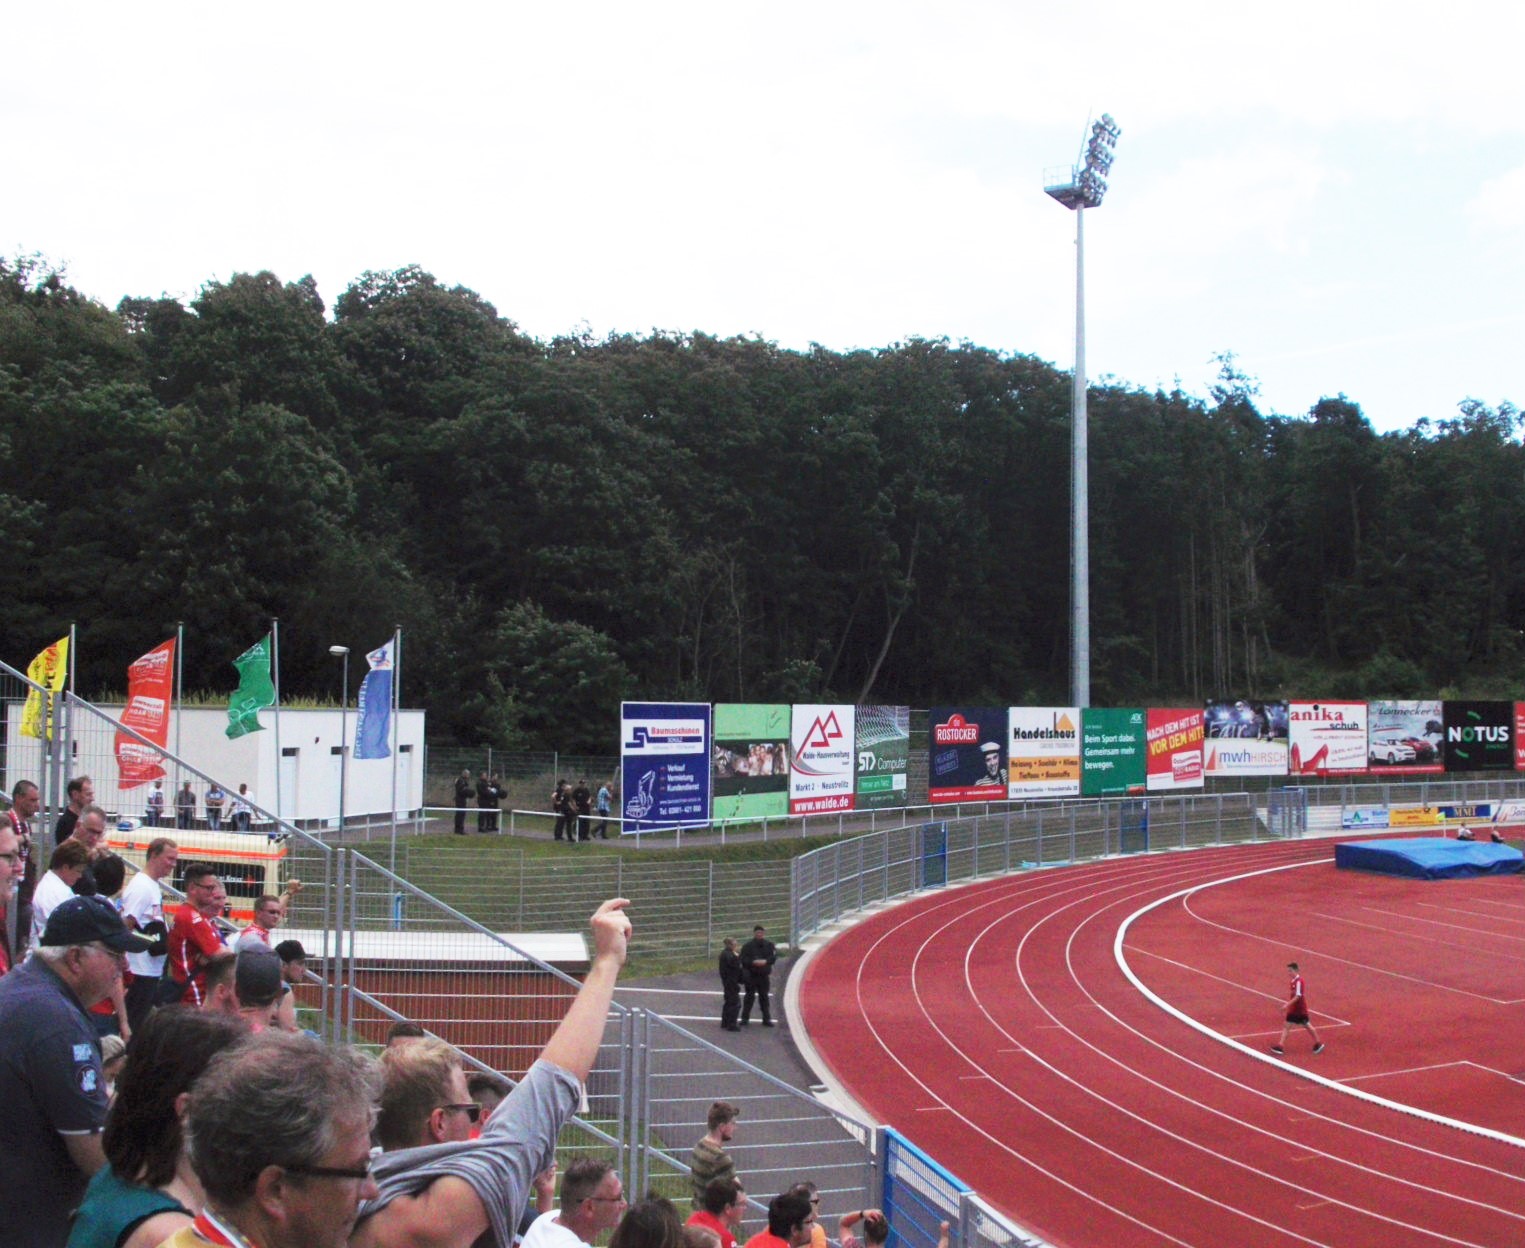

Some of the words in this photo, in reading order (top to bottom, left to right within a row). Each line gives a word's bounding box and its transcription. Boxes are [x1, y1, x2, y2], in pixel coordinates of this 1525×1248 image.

[1290, 705, 1344, 721] anika
[652, 727, 700, 735] Baumaschinen
[1147, 726, 1164, 741] NACH
[1165, 721, 1179, 735] DEM
[1180, 717, 1190, 730] HIT
[1190, 714, 1200, 726] IST
[1330, 721, 1359, 729] schuh
[937, 728, 977, 741] ROSTOCKER
[1014, 727, 1075, 739] Handelshaus
[1085, 734, 1101, 743] Beim
[1102, 734, 1118, 744] Sport
[1448, 726, 1509, 742] NOTUS
[1150, 738, 1168, 756] VOR
[1169, 731, 1187, 749] DEM
[1085, 747, 1120, 756] Gemeinsam
[1121, 746, 1135, 755] mehr
[667, 764, 686, 772] Verkauf
[878, 758, 907, 771] Computer
[667, 783, 700, 792] Kundendienst
[795, 798, 849, 812] www.walde.de
